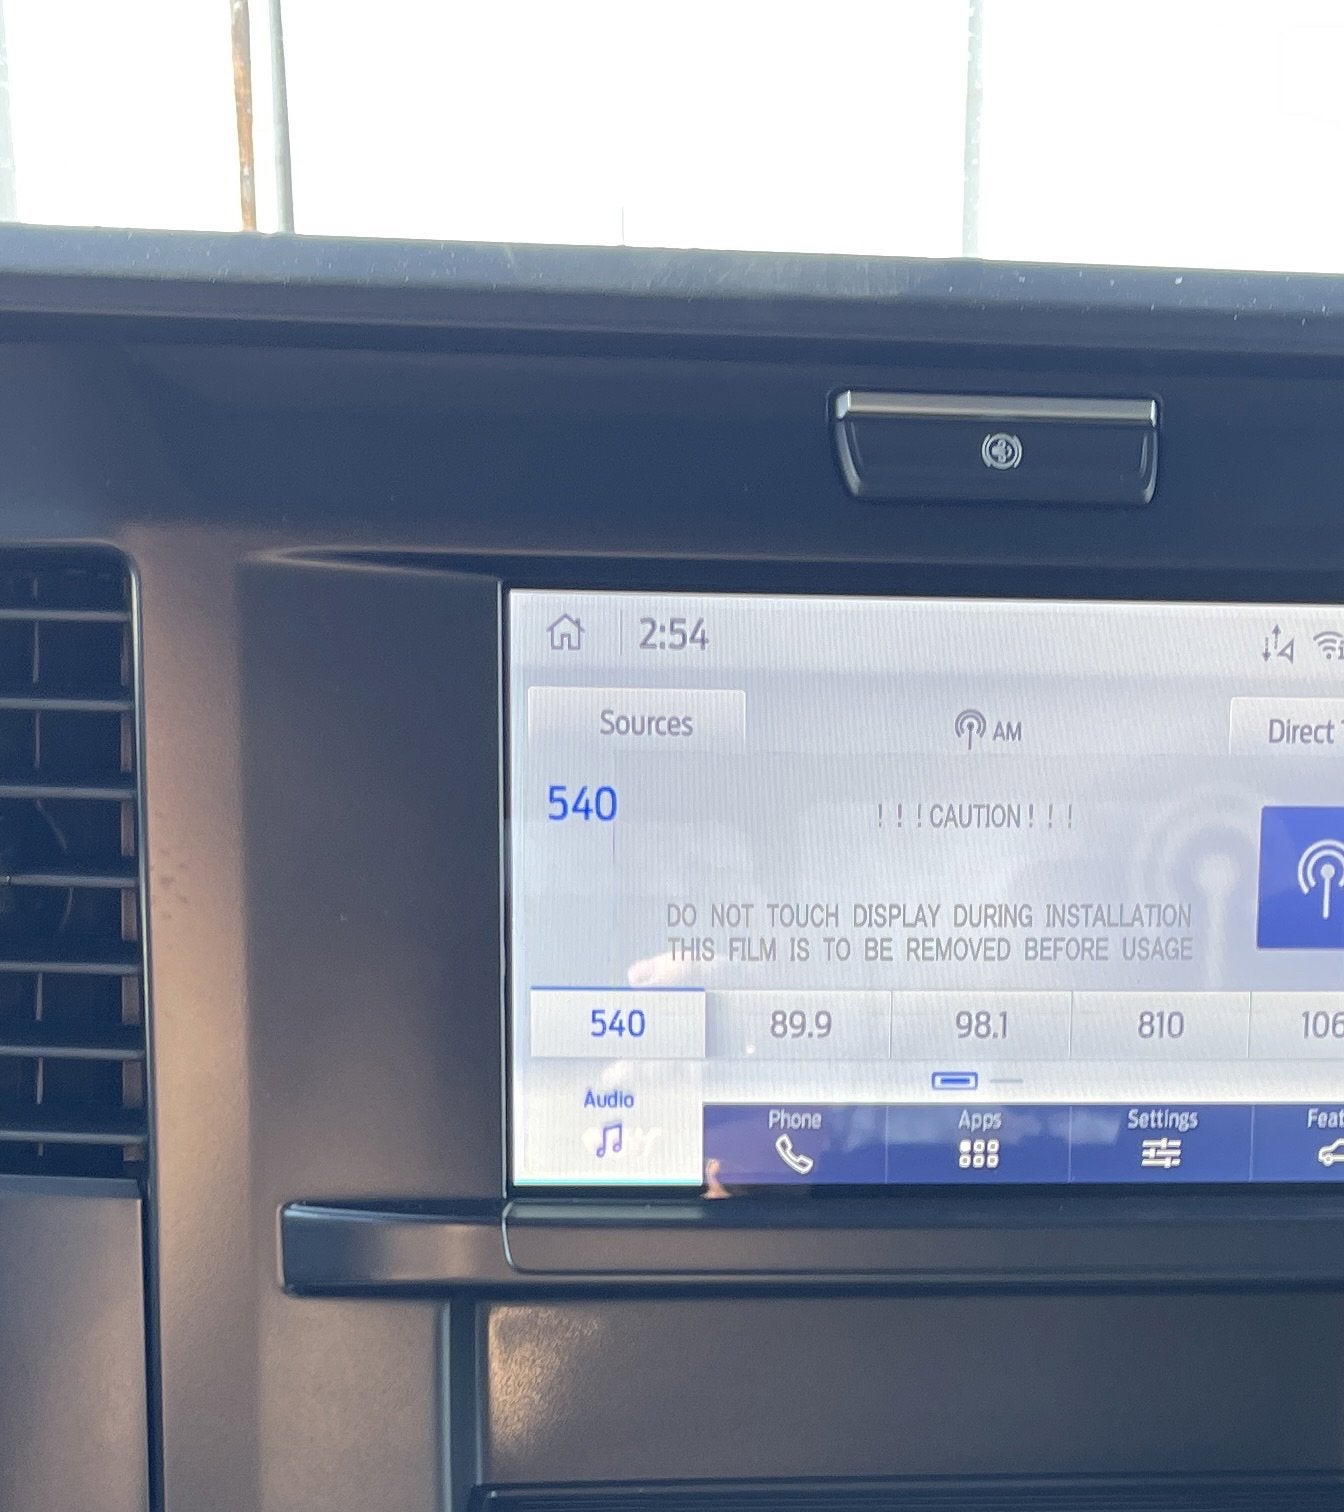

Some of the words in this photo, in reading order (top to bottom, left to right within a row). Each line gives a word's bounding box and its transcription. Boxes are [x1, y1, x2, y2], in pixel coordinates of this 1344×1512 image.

[639, 617, 709, 650] 2:54
[599, 709, 694, 737] Sources
[992, 721, 1022, 742] AM
[1268, 718, 1335, 744] Direct
[548, 785, 618, 822] 540
[667, 903, 697, 928] DO
[711, 903, 754, 928] NOT
[767, 903, 839, 928] TOUCH
[854, 903, 941, 928] DISPLAY
[953, 903, 1032, 928] DURING
[1046, 903, 1192, 928] INSTALLATION
[667, 937, 715, 962] THIS
[729, 937, 777, 962] FILM
[790, 937, 810, 962] IS
[823, 937, 851, 962] TO
[864, 937, 893, 962] BE
[906, 937, 1011, 962] REMOVED
[1024, 937, 1109, 962] BEFORE
[1122, 936, 1194, 961] USAGE
[590, 1009, 646, 1038] 540
[769, 1010, 833, 1039] 89.9
[955, 1010, 1008, 1039] 98.1
[1138, 1010, 1185, 1039] 810
[583, 1089, 635, 1109] Audio
[768, 1108, 823, 1131] Phone
[958, 1109, 1003, 1132] Apps
[1127, 1108, 1199, 1132] Settings
